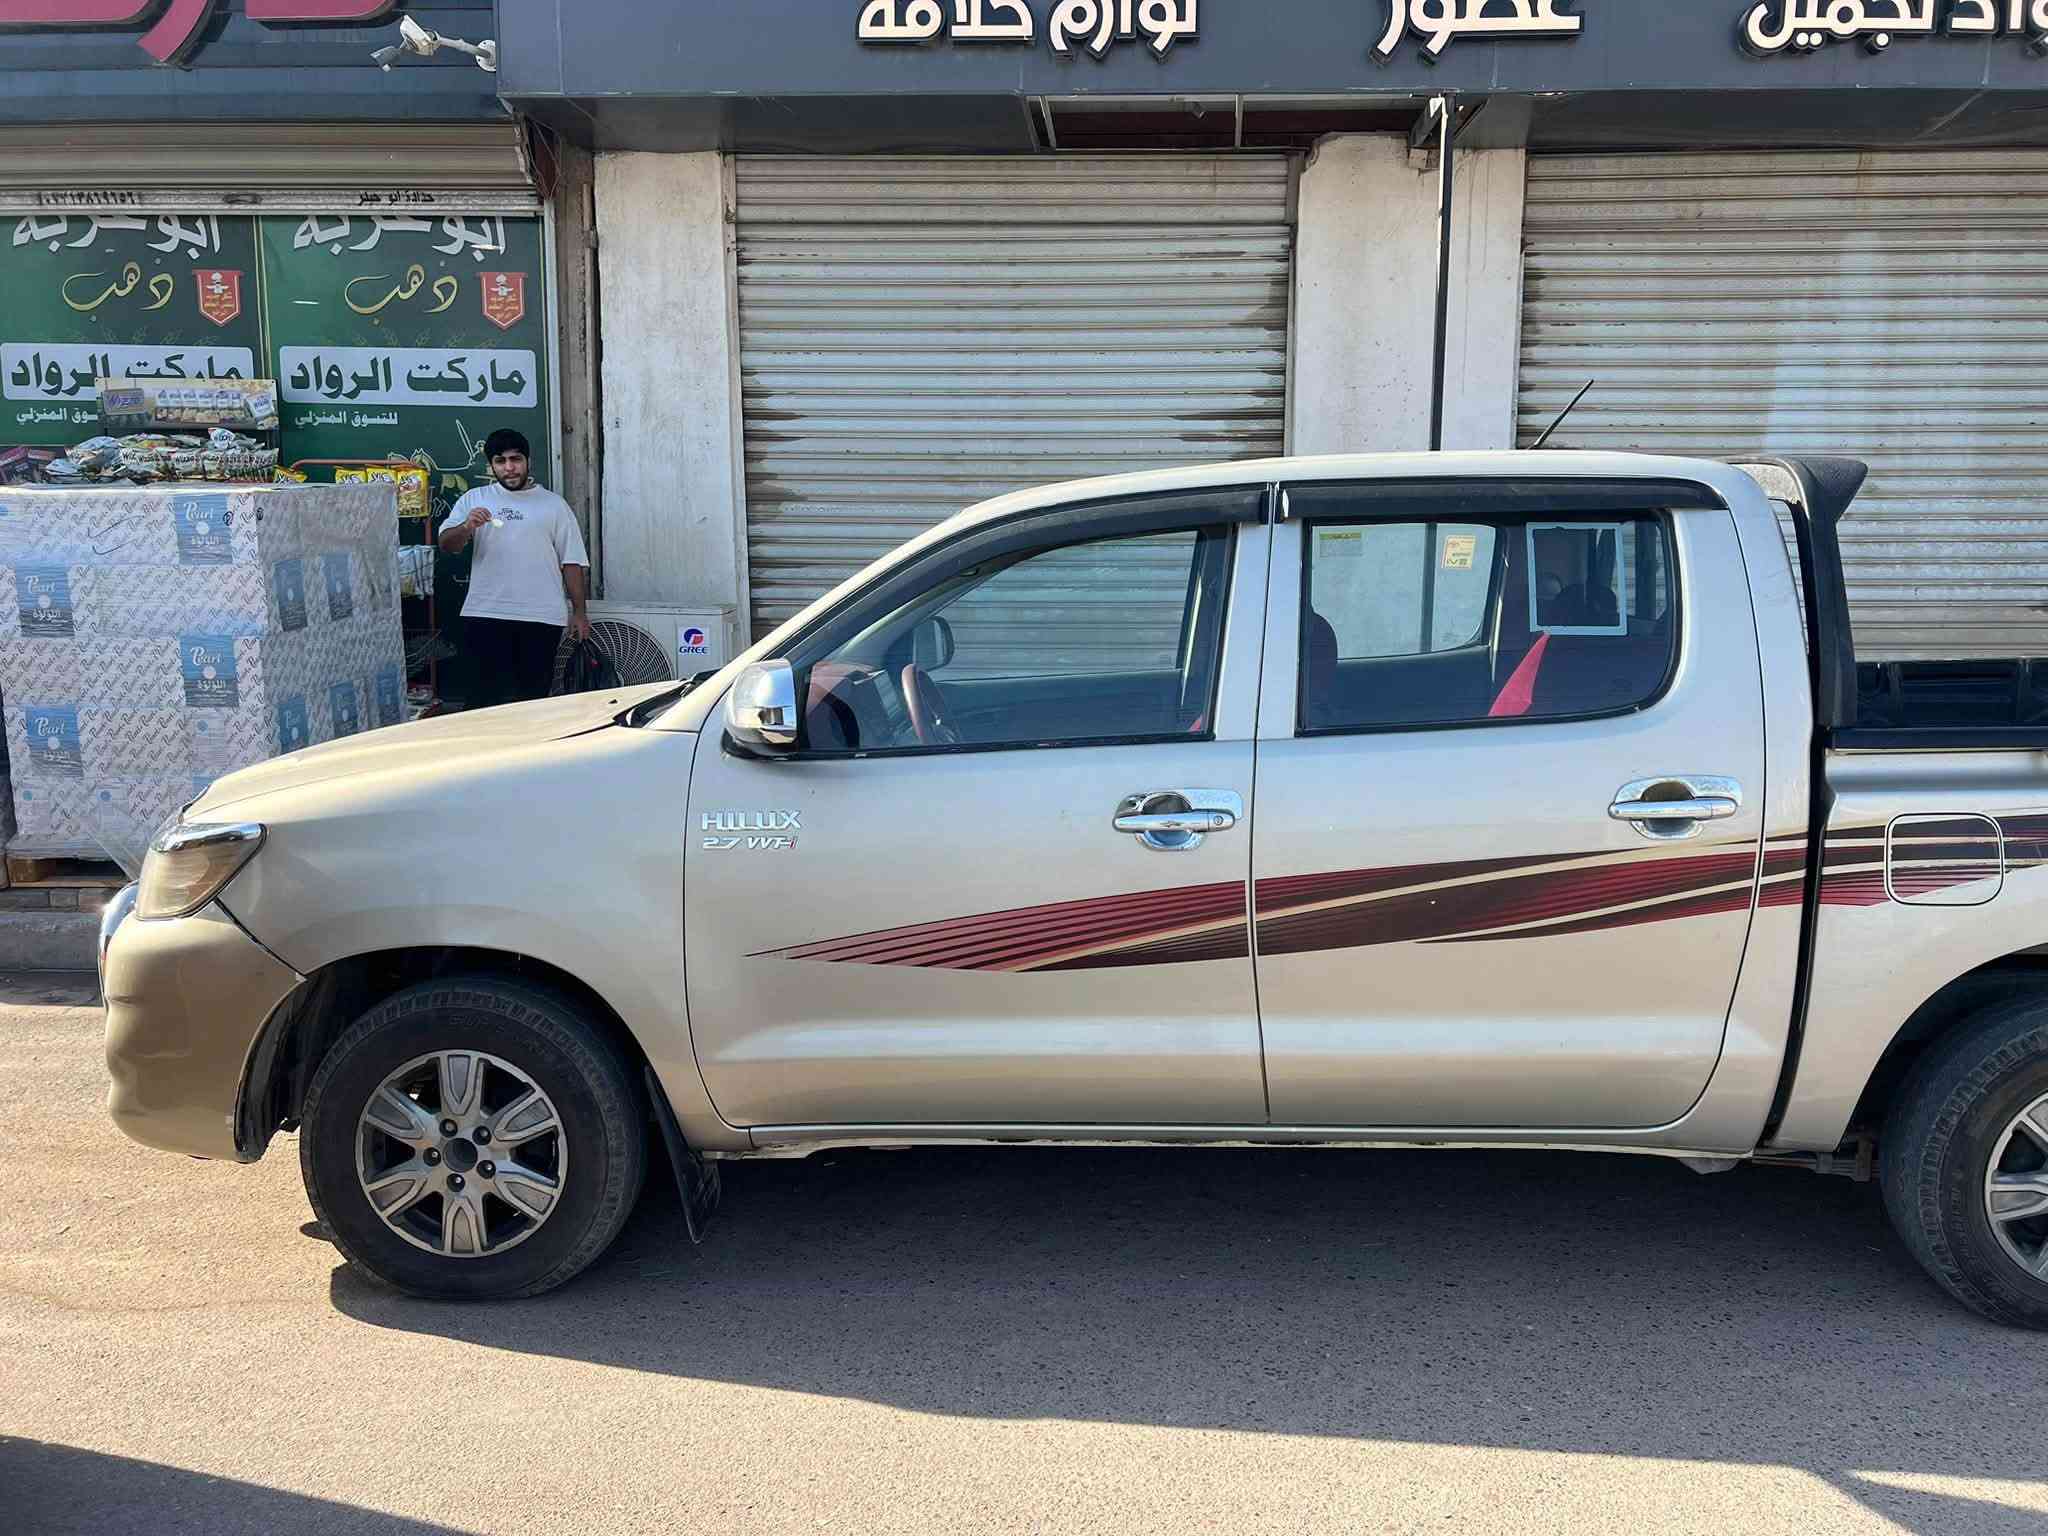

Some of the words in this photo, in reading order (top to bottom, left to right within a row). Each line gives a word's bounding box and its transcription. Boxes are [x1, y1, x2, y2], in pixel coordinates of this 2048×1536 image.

[290, 355, 393, 400] الرواد
[406, 356, 527, 402] ماركت
[679, 646, 711, 655] GREE
[701, 810, 802, 831] HILUX
